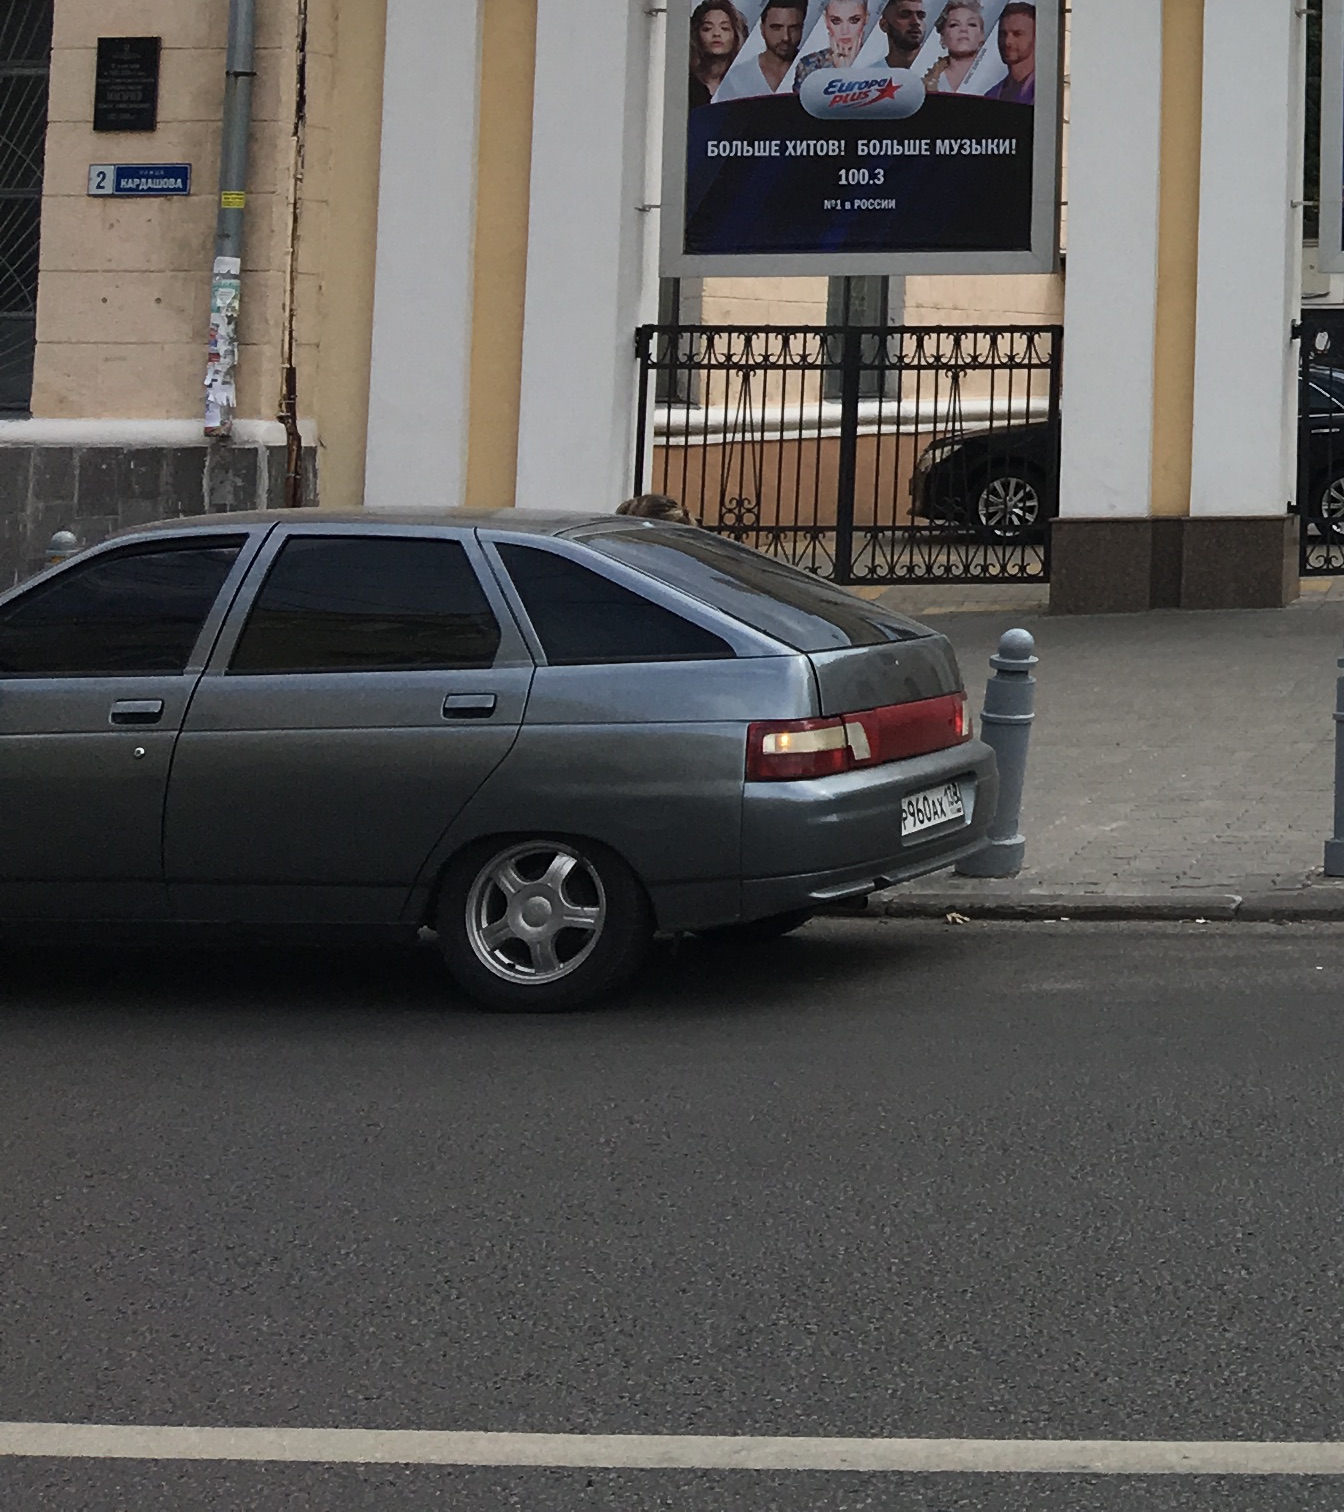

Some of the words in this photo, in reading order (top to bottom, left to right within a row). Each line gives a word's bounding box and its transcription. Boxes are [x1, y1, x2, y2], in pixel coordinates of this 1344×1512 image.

[707, 140, 780, 157] БОЛЬШЕ
[785, 140, 845, 156] ХИТОВ!
[857, 139, 931, 156] БОЛЬШЕ
[935, 138, 1017, 155] МУЗЫКИ!
[95, 170, 107, 190] 2
[120, 178, 183, 190] КАРДАШОВА
[838, 168, 885, 186] 100.3
[824, 199, 841, 210] №1
[854, 199, 896, 210] РОССИИ
